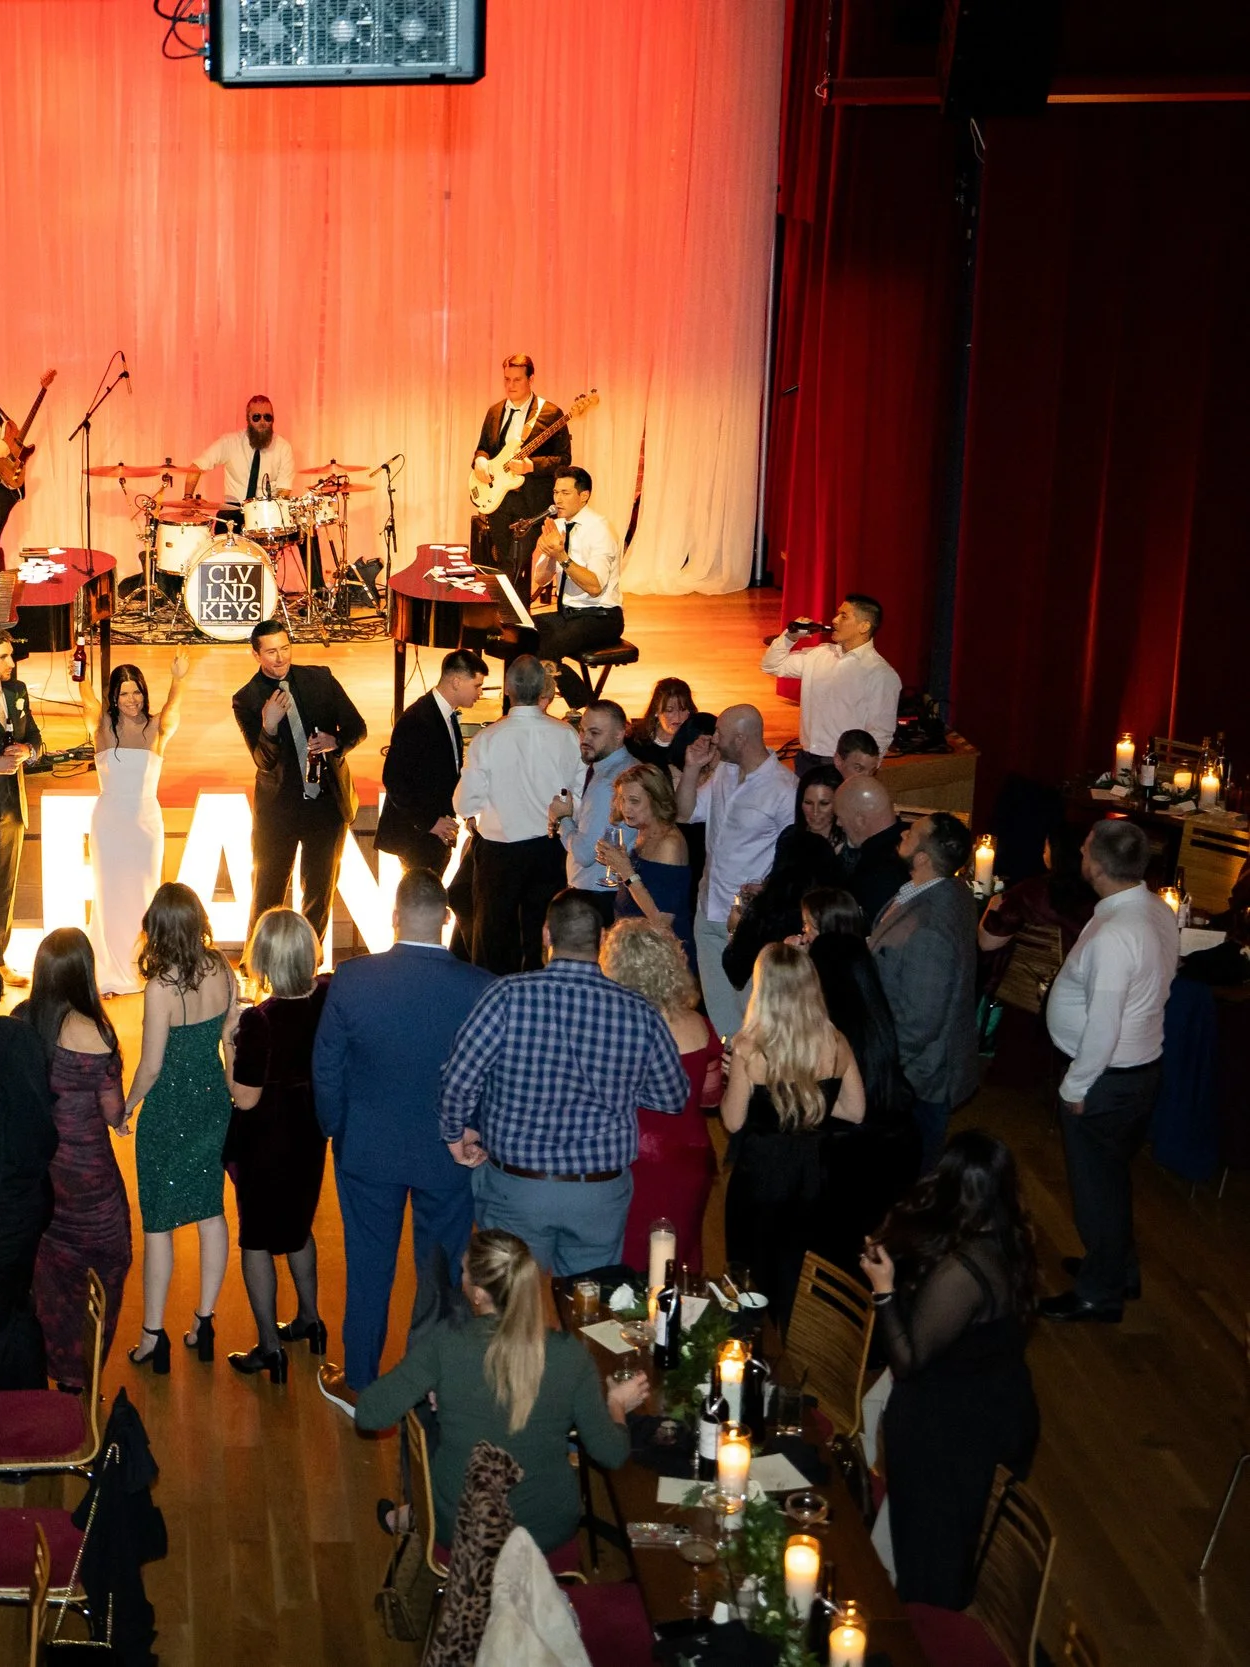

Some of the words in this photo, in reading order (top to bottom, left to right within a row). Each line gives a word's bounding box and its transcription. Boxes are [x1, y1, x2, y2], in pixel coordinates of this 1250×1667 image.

[208, 565, 254, 583] CLV
[206, 584, 256, 601] LND
[201, 602, 261, 620] KEYS
